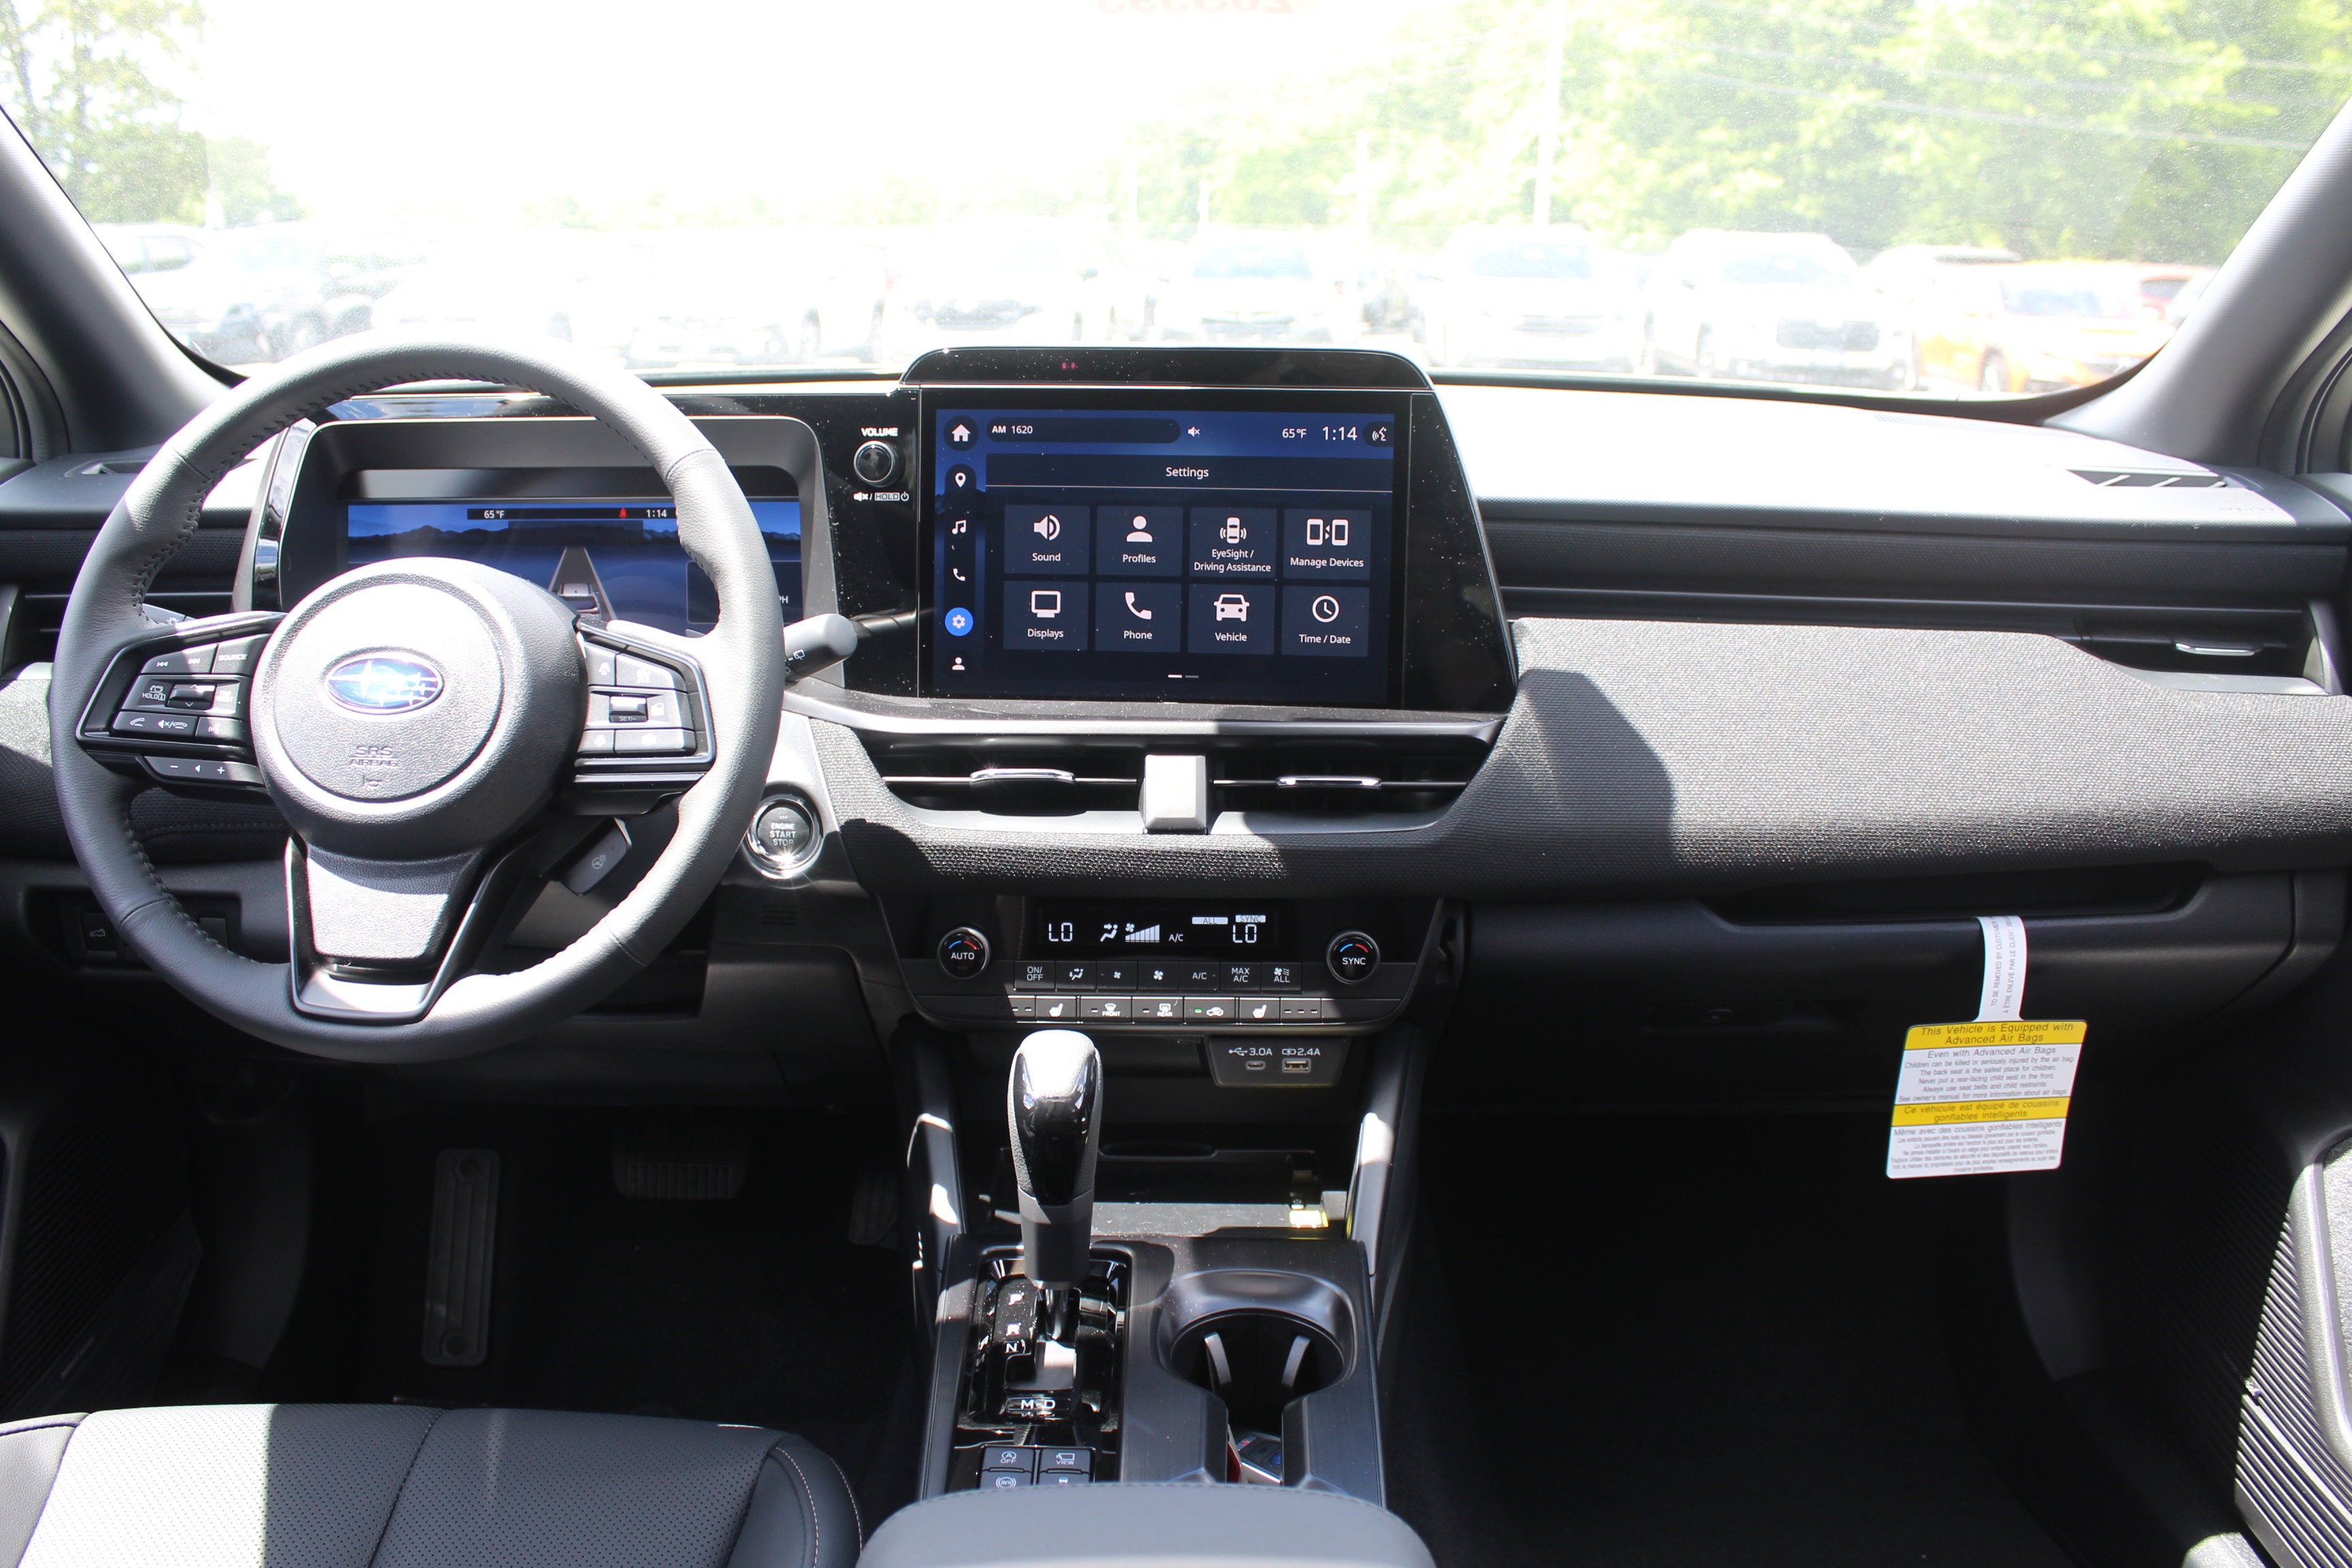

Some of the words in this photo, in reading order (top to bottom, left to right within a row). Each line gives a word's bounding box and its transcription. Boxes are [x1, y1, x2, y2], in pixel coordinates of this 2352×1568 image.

[862, 427, 898, 436] VOLUME
[1323, 427, 1357, 440] 1:14
[1166, 468, 1209, 479] Settings
[1123, 554, 1156, 563] Profiles
[1211, 549, 1247, 560] EyeSight
[1194, 562, 1224, 573] Driving
[1226, 563, 1271, 572] Assistance
[1291, 557, 1327, 568] Manage
[1330, 558, 1364, 567] Devices
[1028, 629, 1064, 640] Displays
[1124, 631, 1152, 639] Phone
[1215, 633, 1247, 641] Vehicle
[1299, 634, 1321, 642] Time
[1330, 635, 1351, 643] Date
[1169, 934, 1183, 942] A/C
[1992, 921, 2002, 950] CUSTOMER
[1028, 966, 1042, 975] ON/
[1232, 968, 1250, 976] MAX
[1993, 962, 2002, 988] REMOVED
[1027, 973, 1043, 981] OFF
[1234, 974, 1249, 982] A/C
[1274, 973, 1290, 982] ALL
[1921, 1027, 1941, 1036] This
[1946, 1024, 1982, 1034] Vehicle
[2000, 1023, 2048, 1034] Equipped
[2053, 1023, 2073, 1031] with
[1945, 1034, 1995, 1045] Advanced
[1999, 1034, 2013, 1043] Air
[2018, 1033, 2044, 1044] Bags
[2034, 1047, 2056, 1055] Bags
[1921, 1105, 1956, 1113] véhicule
[1976, 1102, 2004, 1111] équipé
[2023, 1100, 2059, 1108] coussins
[1934, 1113, 1978, 1124] gonflables
[1982, 1111, 2027, 1120] intelligents
[1009, 1293, 1022, 1305] P
[1007, 1324, 1020, 1335] R
[1006, 1343, 1018, 1352] N
[1021, 1400, 1035, 1409] M
[1045, 1400, 1056, 1409] D
